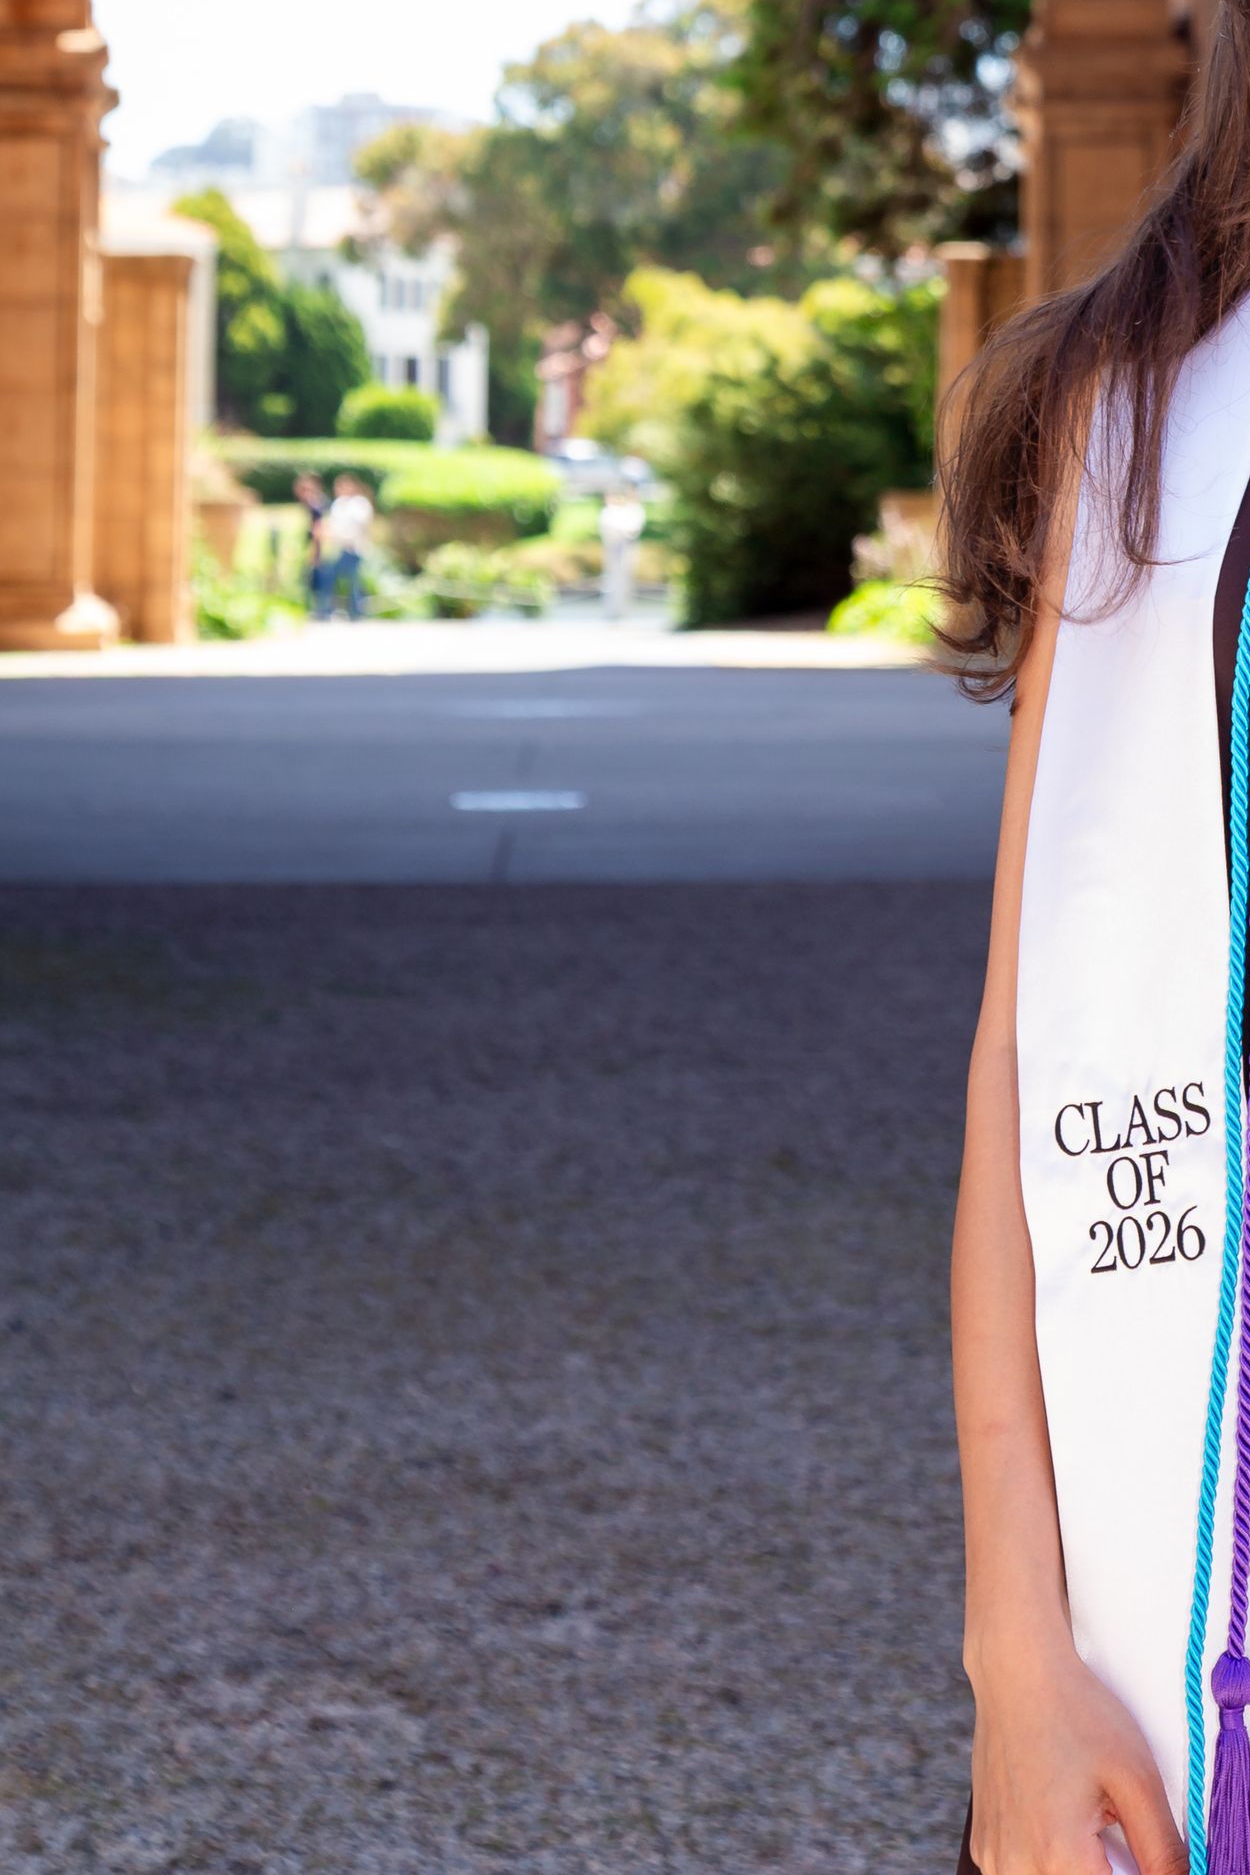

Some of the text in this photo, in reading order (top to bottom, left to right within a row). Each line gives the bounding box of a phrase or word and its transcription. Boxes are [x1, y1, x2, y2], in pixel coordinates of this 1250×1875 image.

[1054, 1081, 1211, 1157] CLASS
[1106, 1149, 1170, 1211] OF
[1088, 1205, 1206, 1274] 2026
